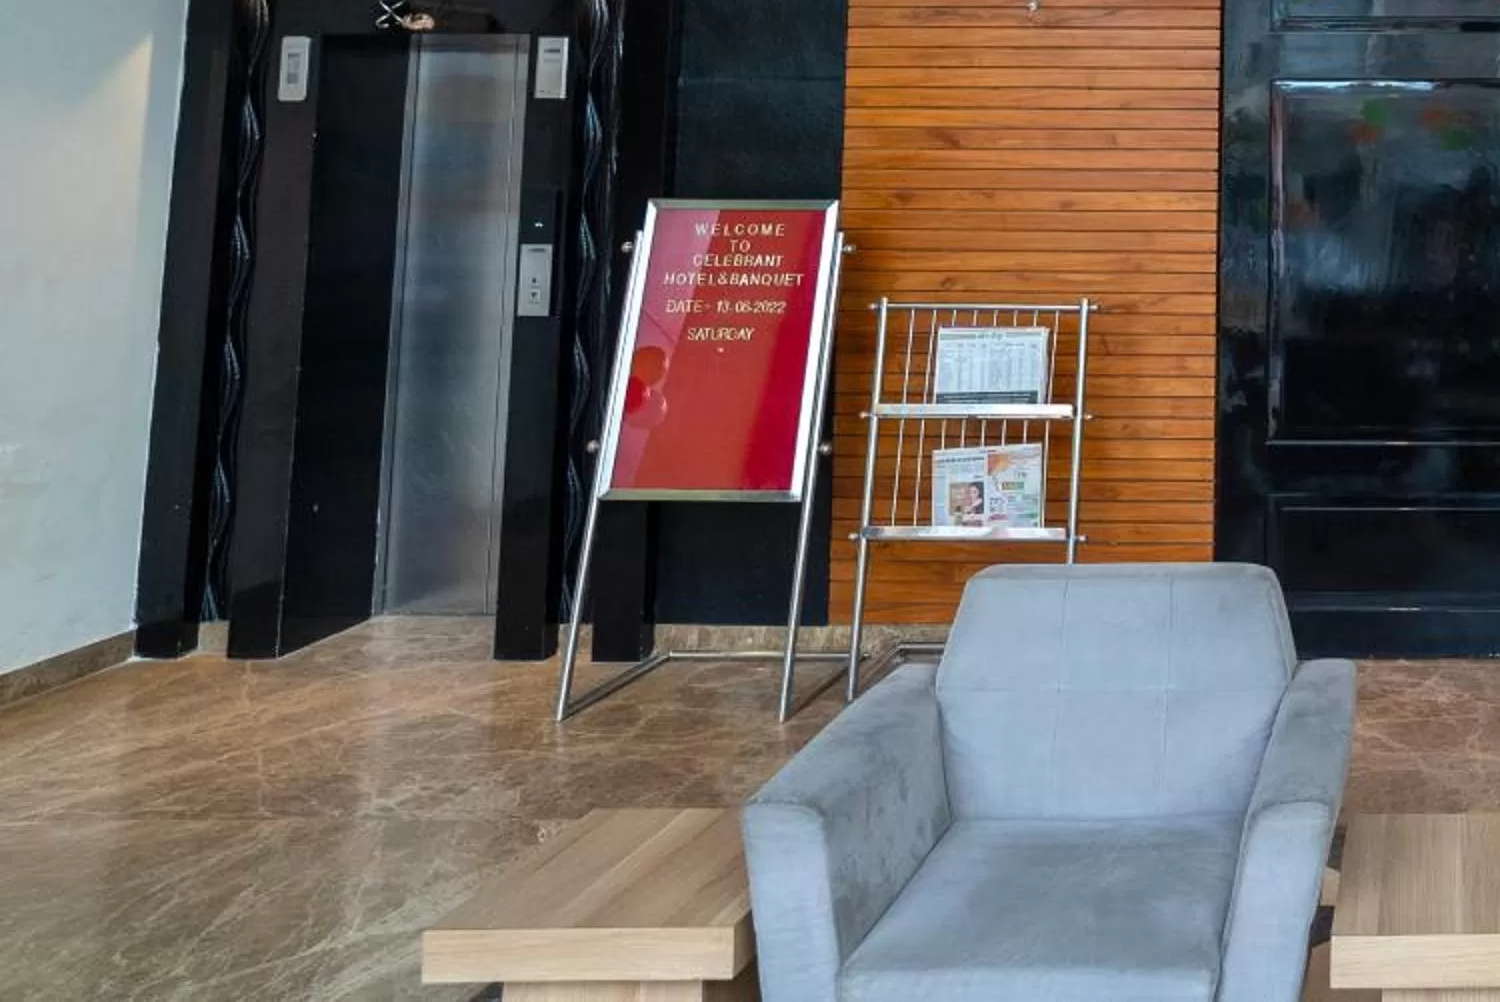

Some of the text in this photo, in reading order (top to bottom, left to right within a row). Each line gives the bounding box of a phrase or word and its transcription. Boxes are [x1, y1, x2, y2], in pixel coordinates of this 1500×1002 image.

[695, 223, 785, 237] WELCOME
[730, 239, 751, 253] TO
[693, 253, 784, 267] CELEBRANT
[687, 328, 755, 341] SATURDAY
